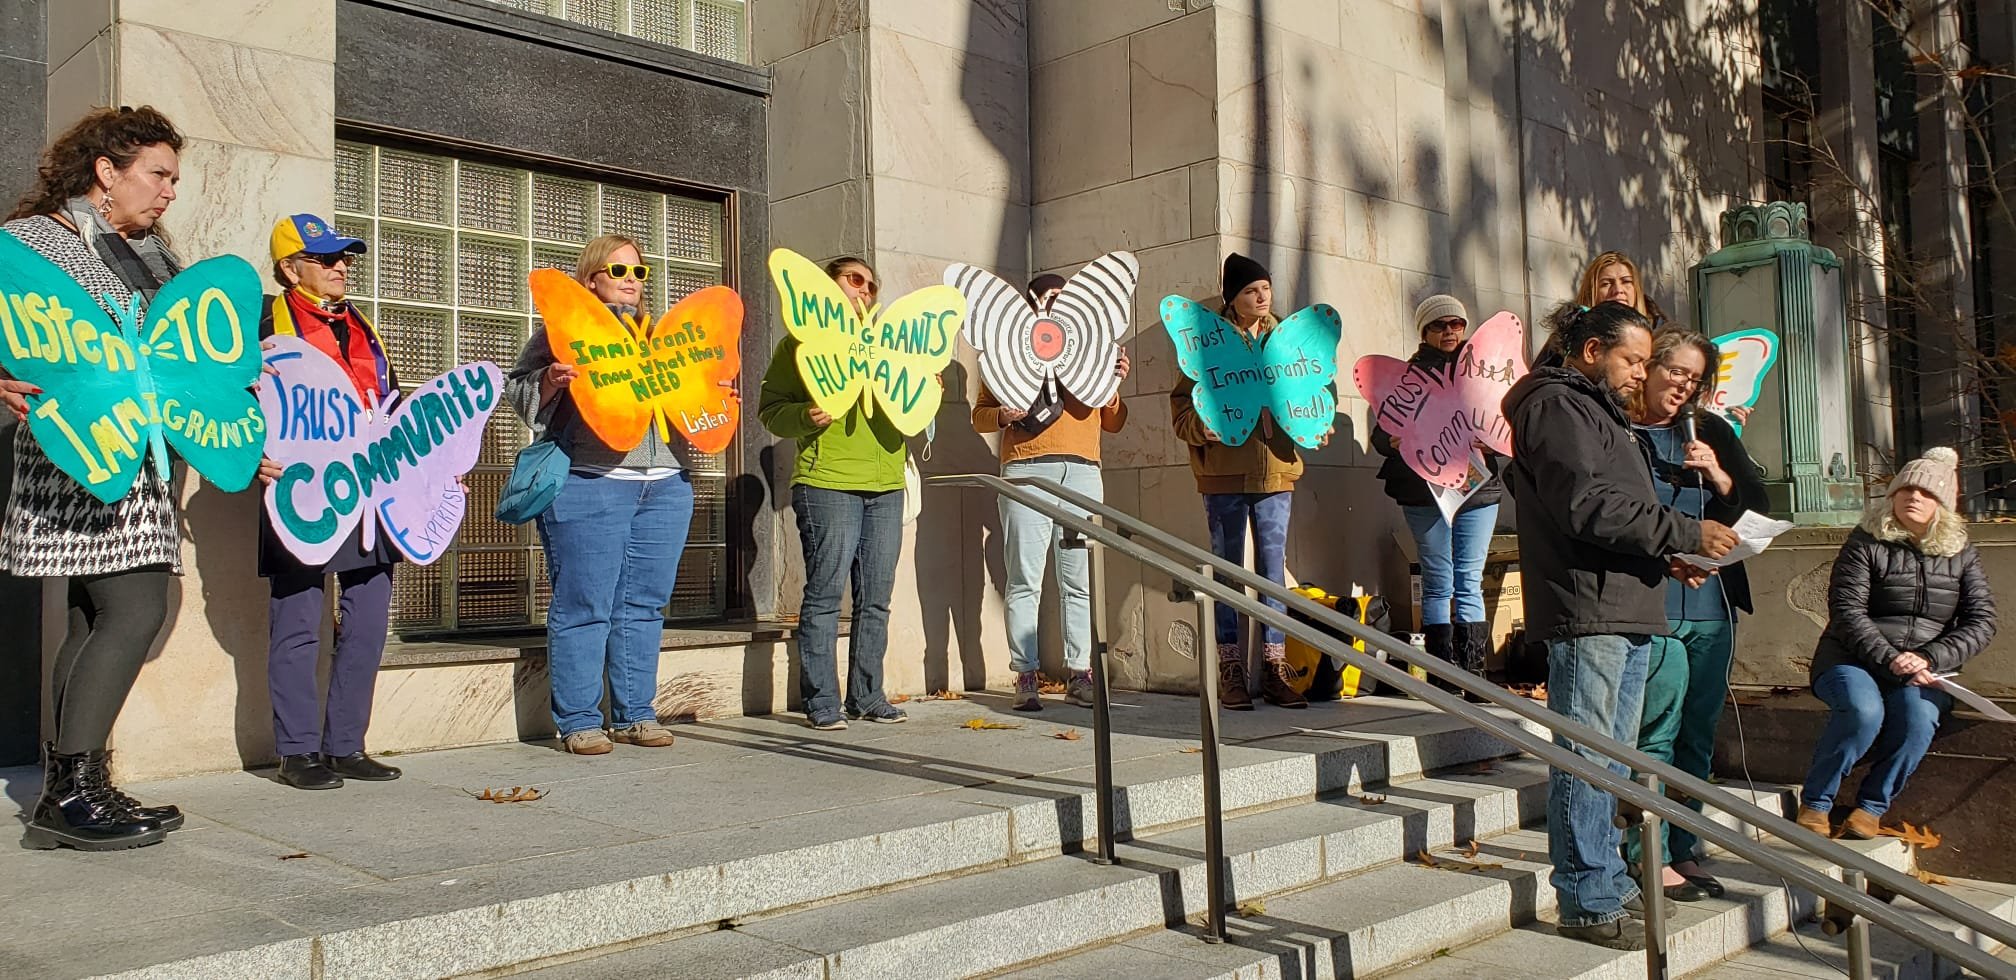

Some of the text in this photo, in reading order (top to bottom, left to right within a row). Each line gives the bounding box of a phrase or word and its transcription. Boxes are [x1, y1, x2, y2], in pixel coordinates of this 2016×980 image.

[166, 287, 244, 363] TO
[783, 270, 958, 357] IMMIGRANTS
[848, 342, 877, 360] ARE
[1178, 319, 1225, 353] Trust
[588, 344, 725, 390] Know What they
[629, 371, 681, 402] NEED
[805, 353, 927, 414] HUMAN
[1206, 347, 1323, 390] Immigrants
[264, 351, 361, 442] TRUST
[680, 400, 732, 434] Listen!
[1222, 394, 1325, 423] to lead!
[1377, 363, 1429, 428] TRUST
